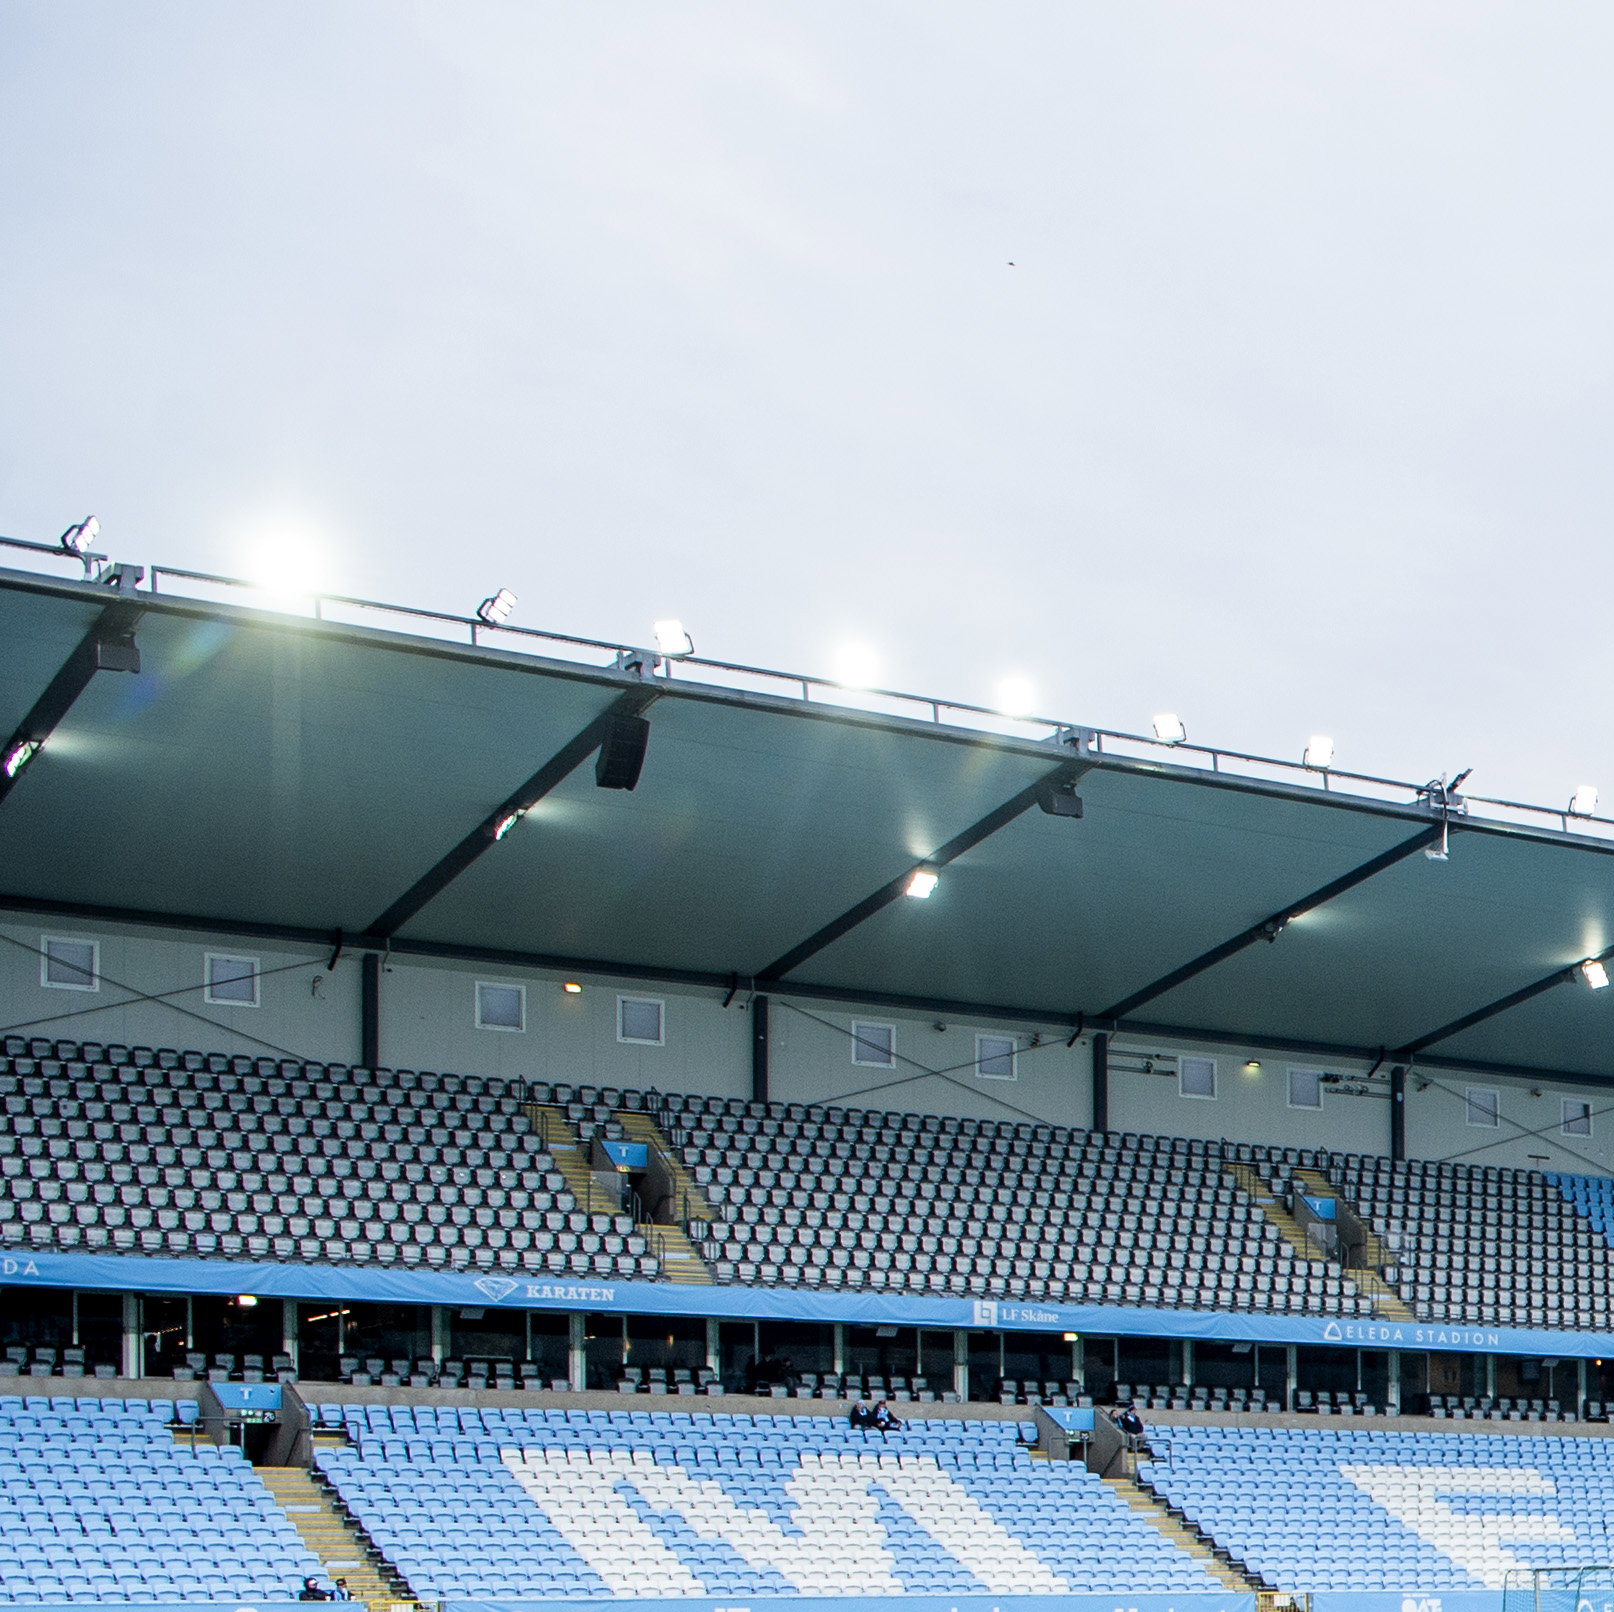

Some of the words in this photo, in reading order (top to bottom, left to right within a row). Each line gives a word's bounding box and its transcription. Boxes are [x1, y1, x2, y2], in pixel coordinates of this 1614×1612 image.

[4, 1259, 38, 1275] DA
[527, 1285, 615, 1301] KARATEN
[1002, 1308, 1019, 1321] LF
[1021, 1308, 1058, 1323] Skåne
[1346, 1326, 1403, 1341] ELEDA
[1416, 1330, 1498, 1345] STADION
